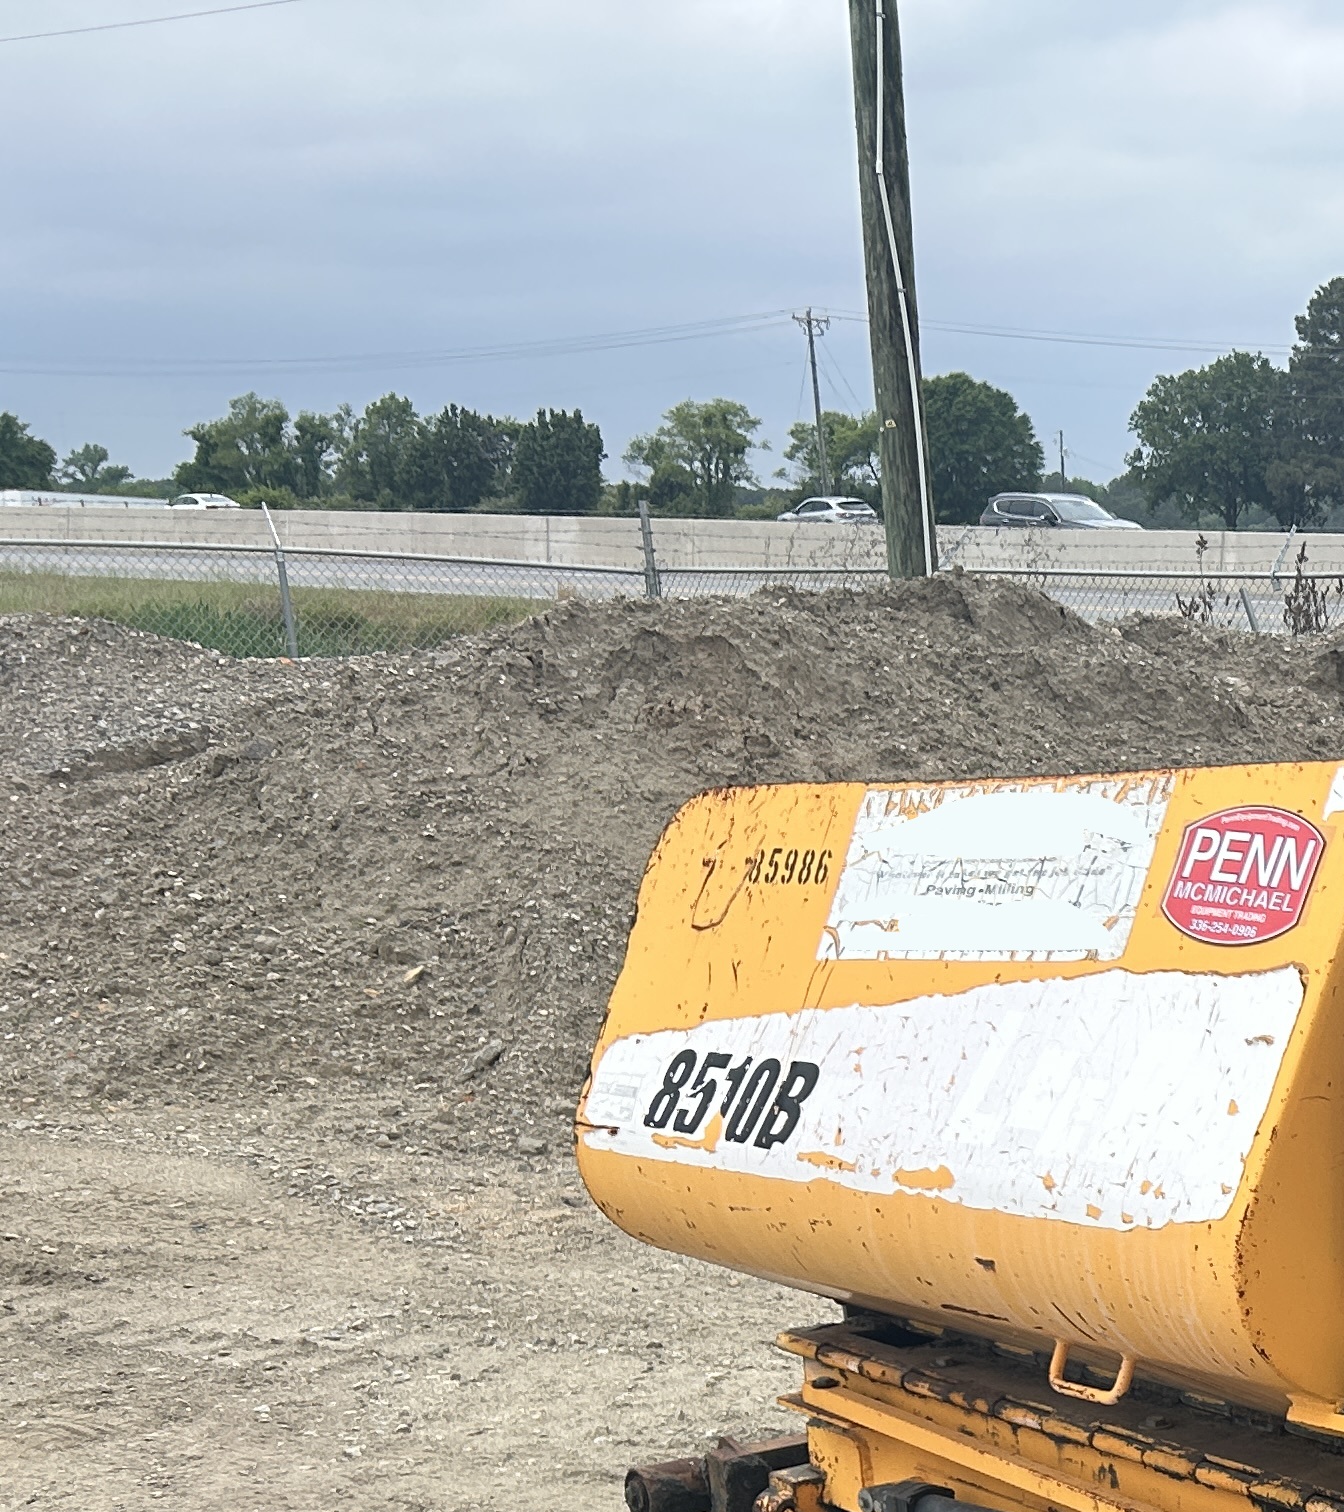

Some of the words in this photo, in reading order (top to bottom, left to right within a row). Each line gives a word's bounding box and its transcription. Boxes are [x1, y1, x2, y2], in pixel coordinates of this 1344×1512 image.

[1181, 828, 1316, 891] PENN
[1173, 880, 1293, 912] MCMICHAEL
[643, 1048, 820, 1150] 8510B
